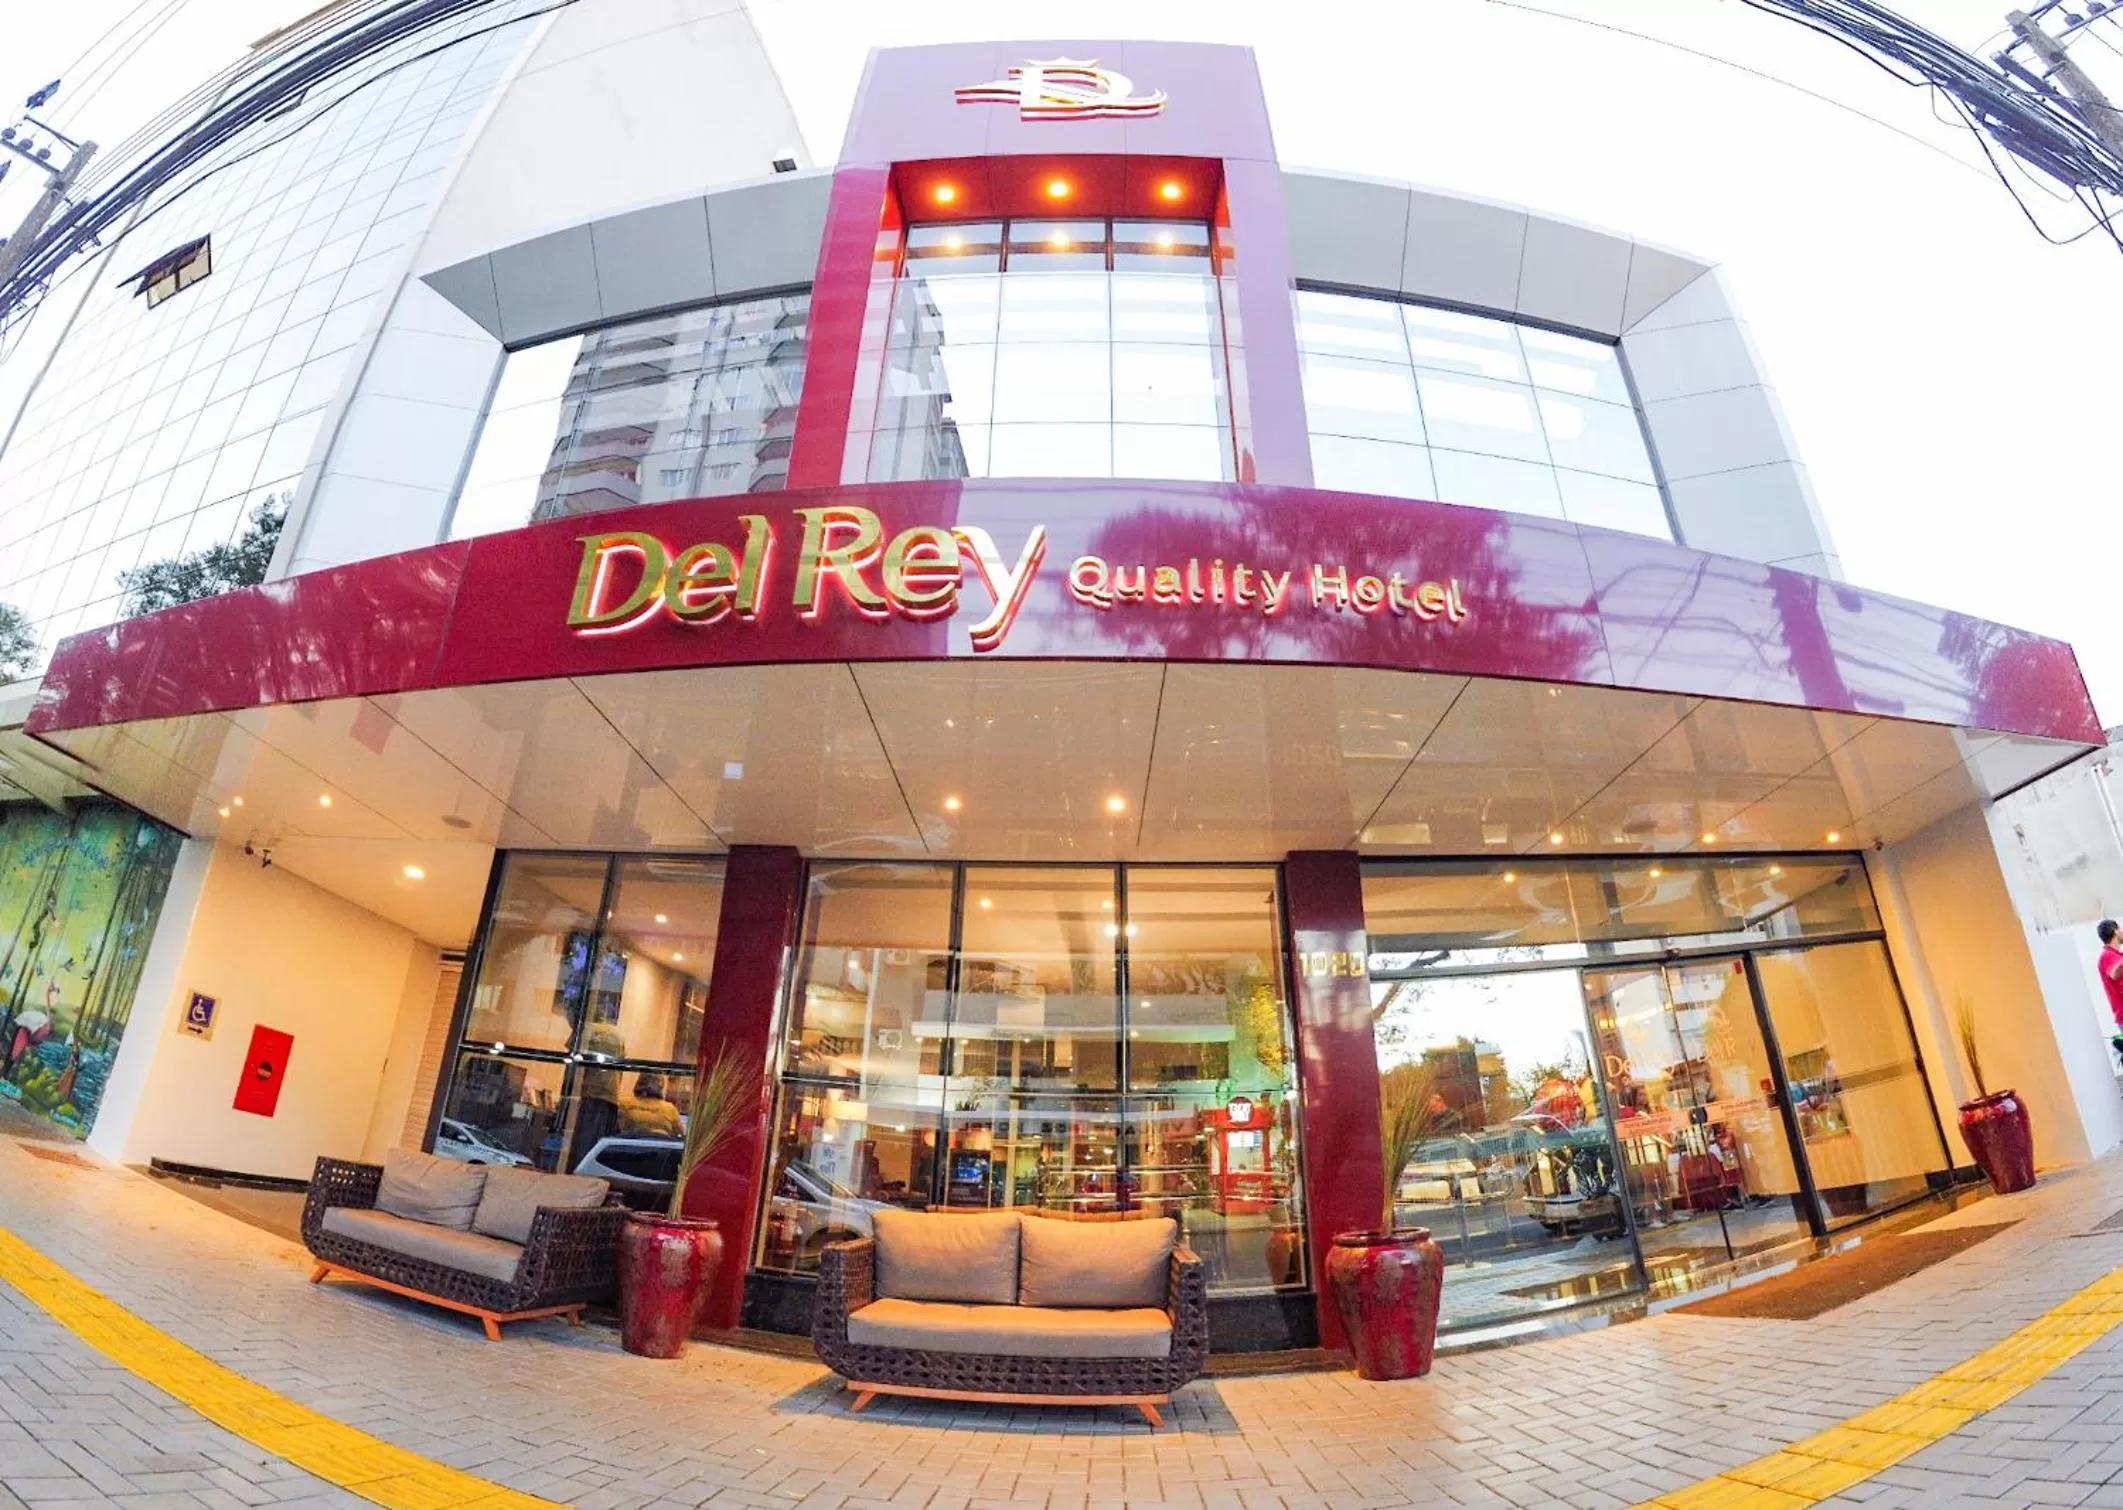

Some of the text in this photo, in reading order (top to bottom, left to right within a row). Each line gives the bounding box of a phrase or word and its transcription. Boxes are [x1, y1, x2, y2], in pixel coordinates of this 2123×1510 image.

[567, 506, 1467, 653] Del Rey Quality Hotel
